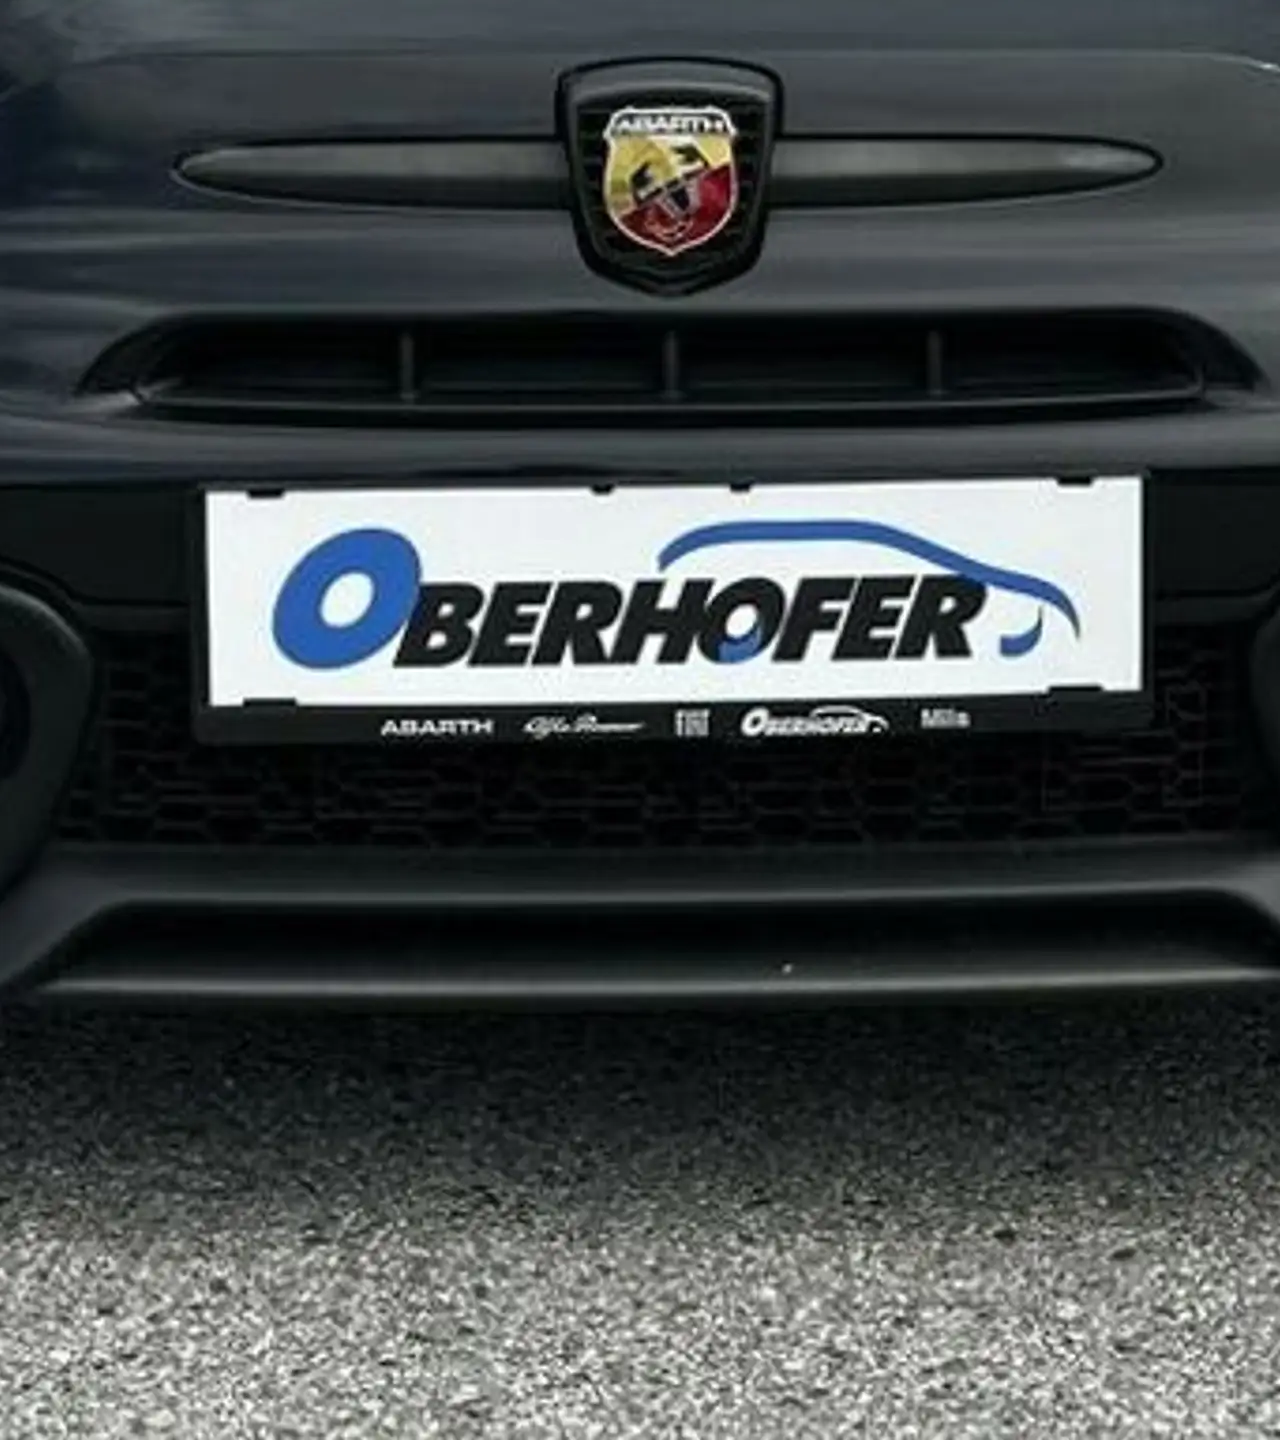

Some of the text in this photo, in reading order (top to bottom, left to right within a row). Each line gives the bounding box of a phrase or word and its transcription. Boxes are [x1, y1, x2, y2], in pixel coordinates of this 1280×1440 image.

[618, 115, 727, 134] ABARTH
[272, 527, 988, 669] OBERHOFER
[380, 718, 494, 737] ABARTH
